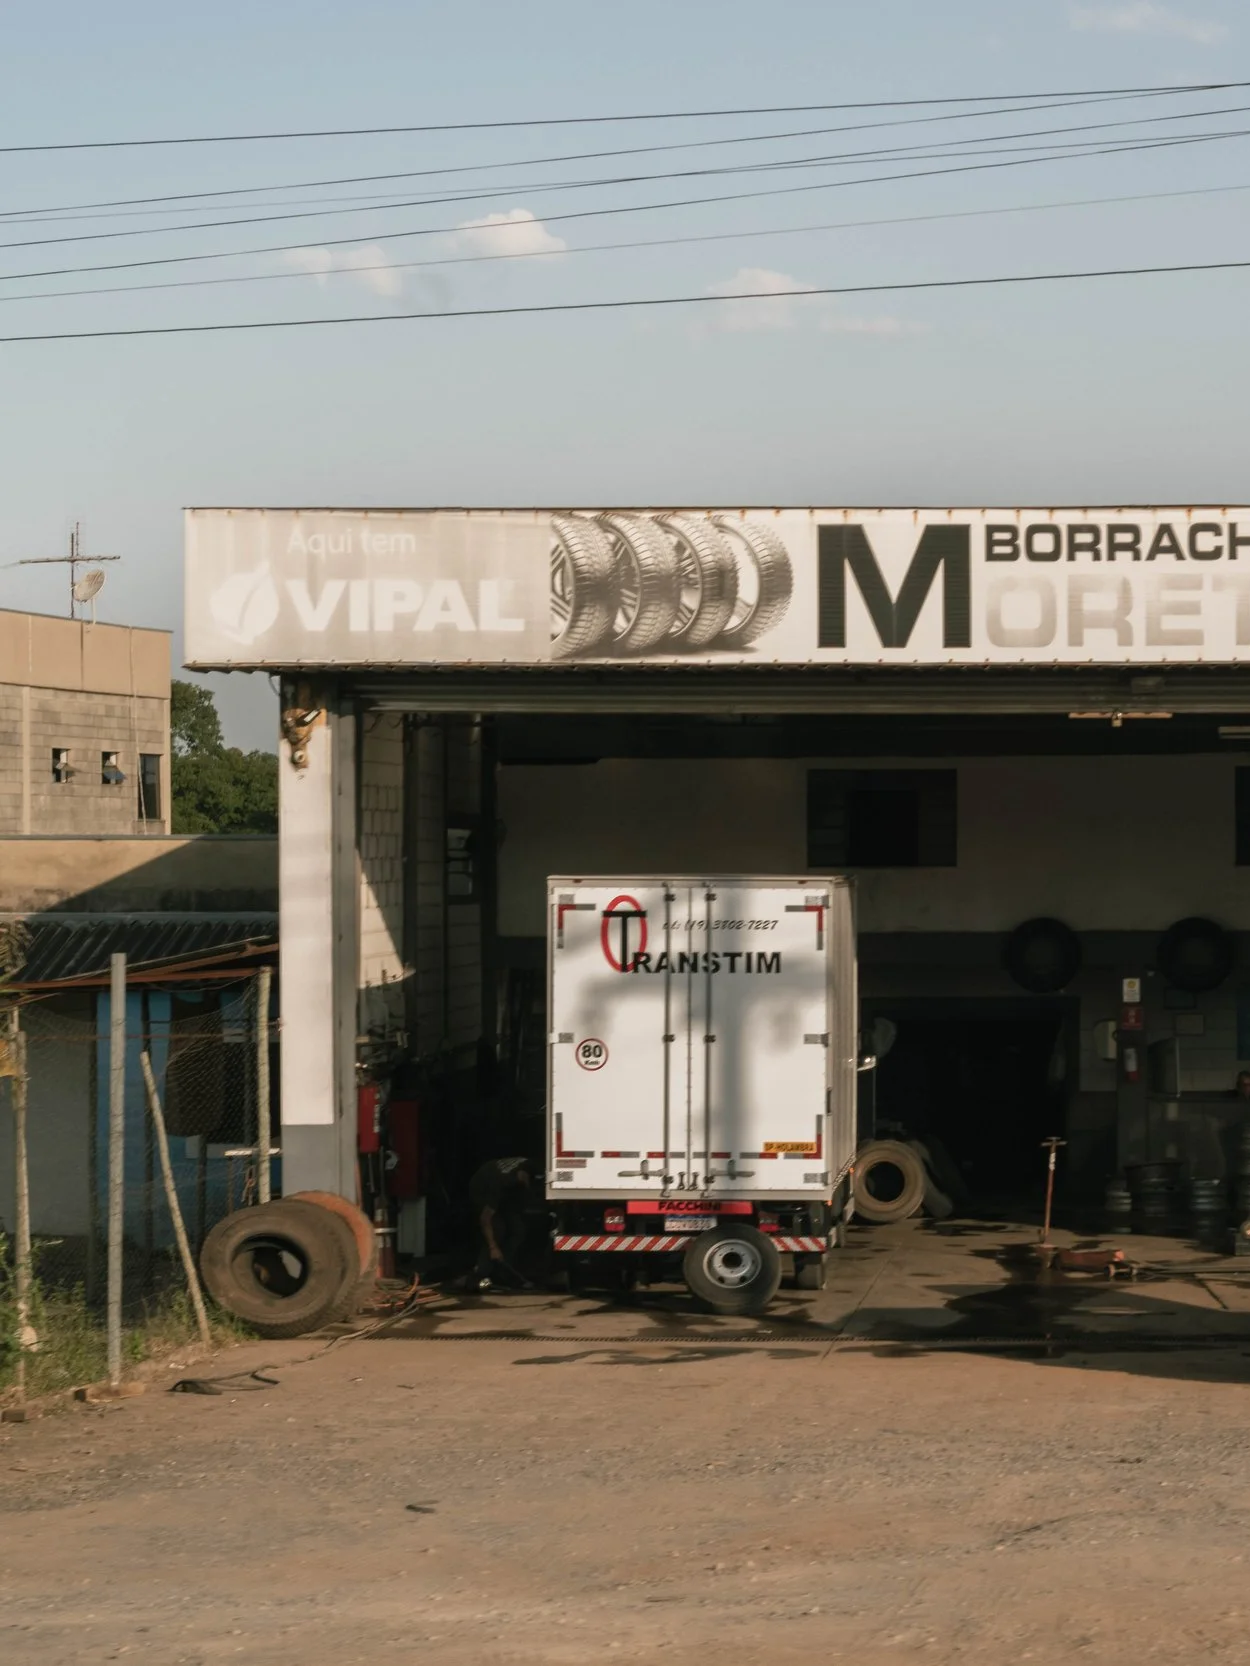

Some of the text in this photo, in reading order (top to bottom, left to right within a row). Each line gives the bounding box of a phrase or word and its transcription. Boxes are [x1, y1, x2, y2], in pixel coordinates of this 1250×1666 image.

[286, 524, 417, 563] Aqui tem
[284, 579, 525, 632] VIPAL
[602, 910, 782, 974] TRANSTIM
[582, 1044, 603, 1058] 80
